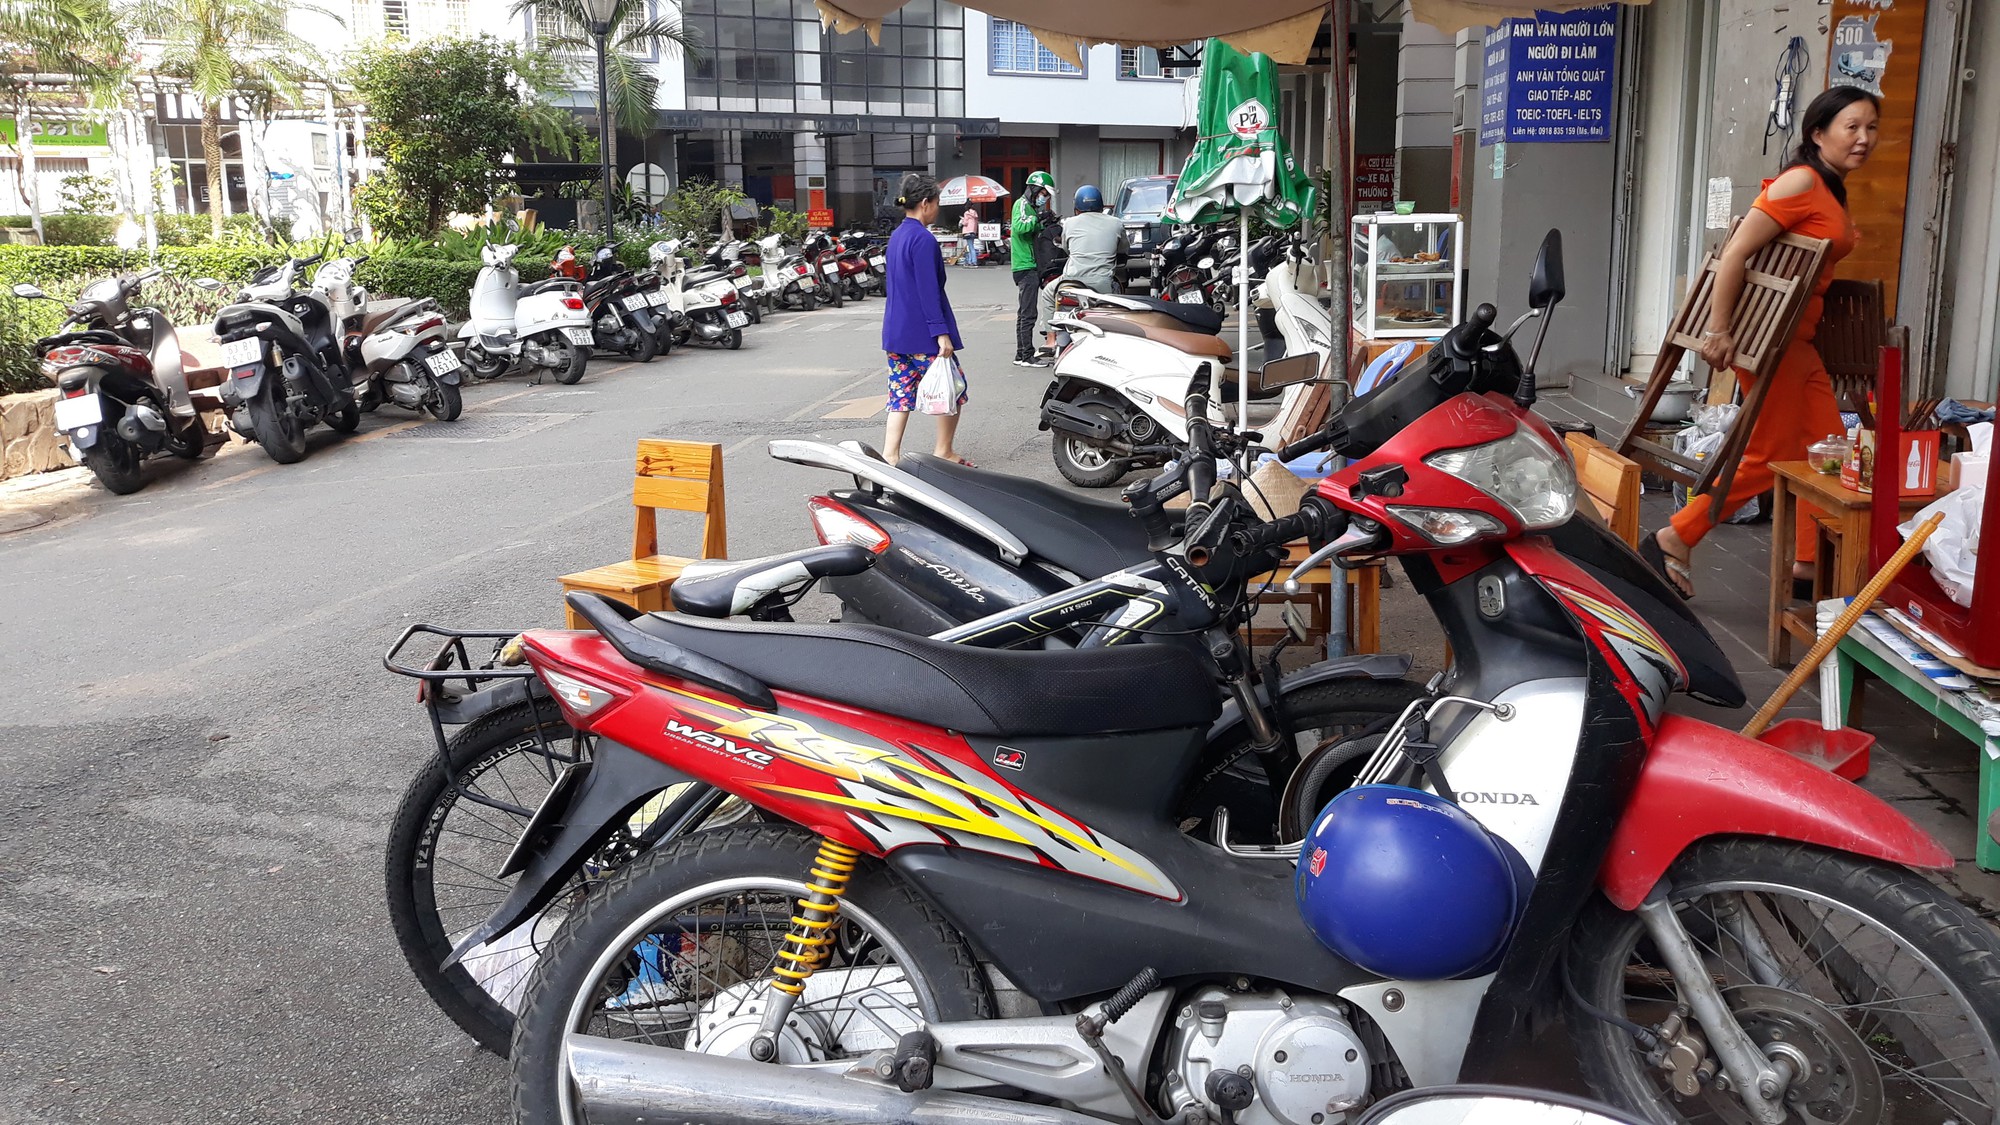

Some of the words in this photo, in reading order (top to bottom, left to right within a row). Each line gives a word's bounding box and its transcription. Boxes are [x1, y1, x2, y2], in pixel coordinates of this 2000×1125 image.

[1513, 24, 1533, 36] ANH
[1560, 20, 1591, 36] NGƯỜI
[1593, 20, 1614, 36] LỚN
[1836, 27, 1864, 46] 500
[1527, 43, 1558, 59] NGƯỜI
[1561, 46, 1572, 59] ĐI
[1574, 43, 1597, 59] LÀM
[1516, 71, 1534, 82] ANH
[1536, 69, 1554, 82] VĂN
[1556, 65, 1580, 82] TỔNG
[1581, 68, 1605, 82] QUÁT
[1527, 90, 1549, 101] GIAO
[1512, 127, 1526, 135] Liên
[1538, 127, 1552, 135] 0918
[1553, 127, 1564, 135] 835
[1565, 127, 1576, 135] 159
[1368, 173, 1378, 183] XE
[1379, 173, 1390, 183] RA
[970, 185, 989, 196] 3G
[1166, 557, 1216, 610] CATANI
[1060, 605, 1075, 615] ATX
[663, 731, 694, 745] URBAN
[695, 743, 731, 758] SPORTY
[732, 756, 766, 771] MOVER
[1289, 1073, 1345, 1083] HONDA
